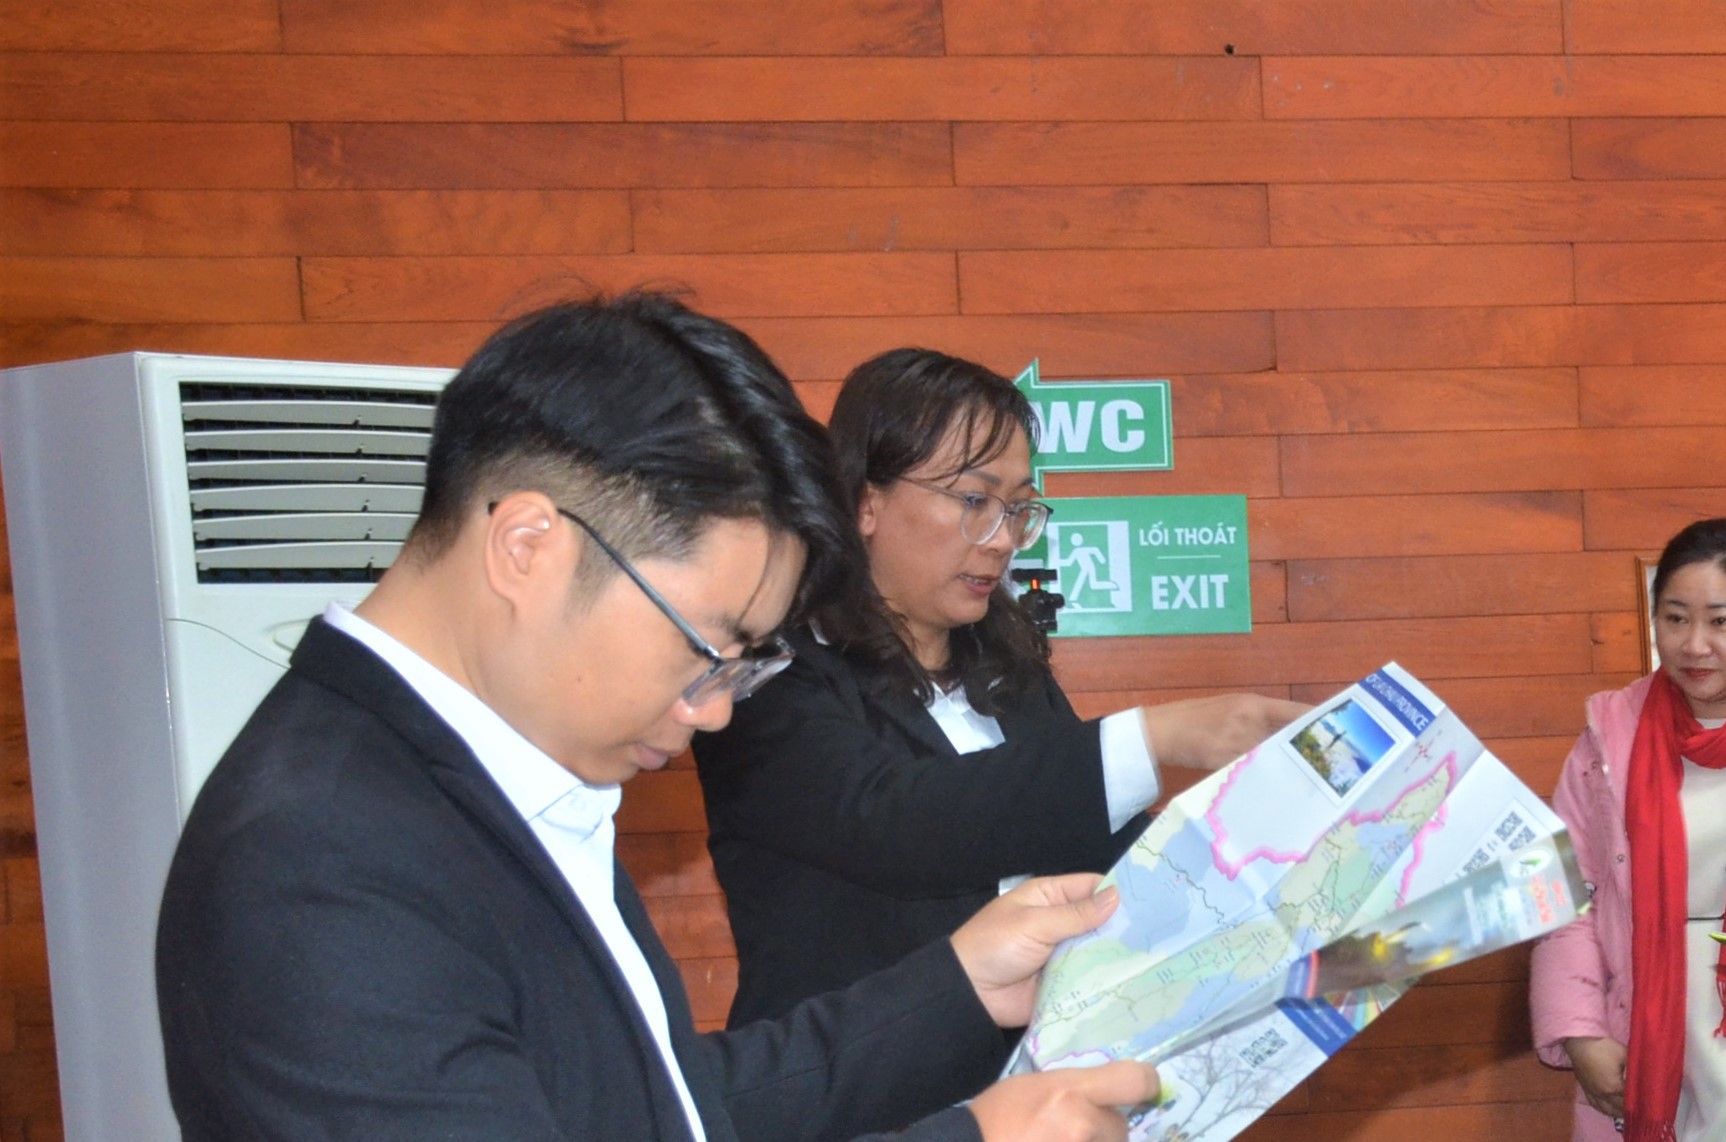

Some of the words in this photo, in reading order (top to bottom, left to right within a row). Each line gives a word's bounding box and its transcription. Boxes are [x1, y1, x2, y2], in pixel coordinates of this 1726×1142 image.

[1031, 399, 1145, 453] WC
[1139, 521, 1169, 547] LỐI
[1174, 523, 1237, 545] THOÁT
[1151, 574, 1229, 610] EXIT
